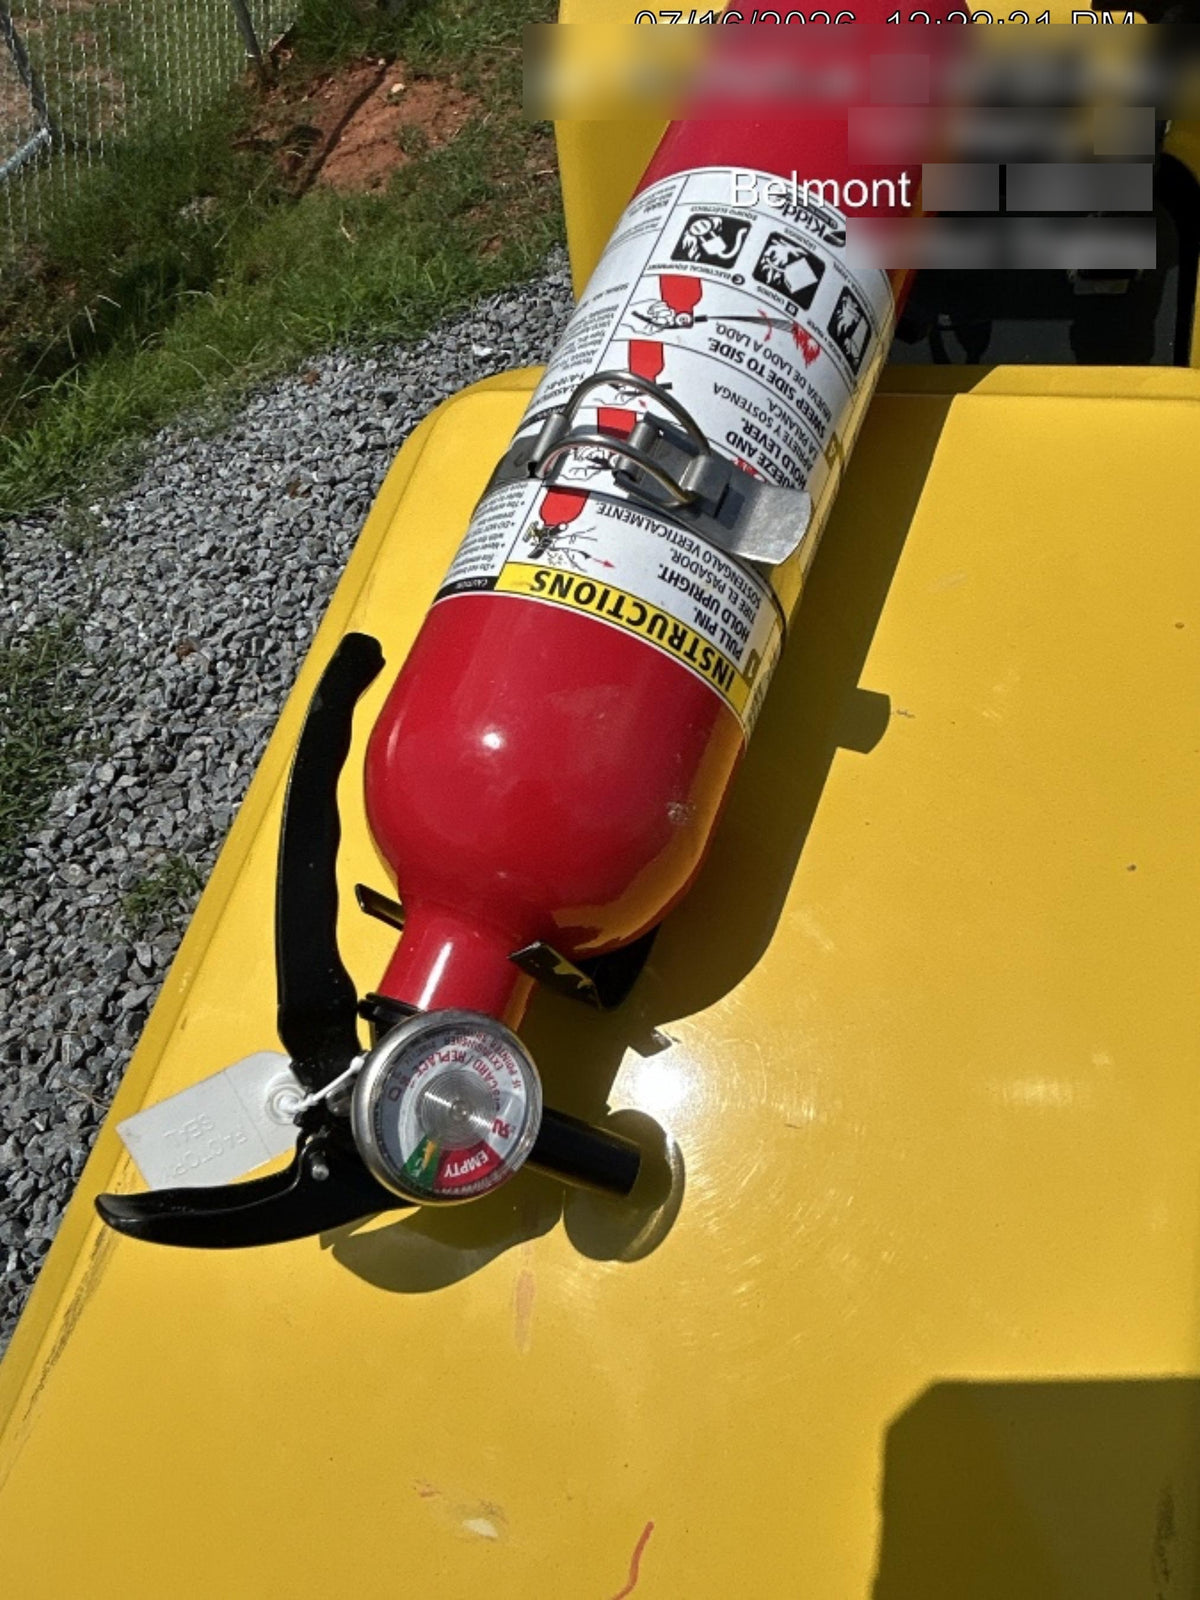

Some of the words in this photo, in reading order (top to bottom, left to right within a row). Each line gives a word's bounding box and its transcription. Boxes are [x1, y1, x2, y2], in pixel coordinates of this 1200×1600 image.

[714, 320, 751, 347] LADO.
[752, 340, 767, 353] A
[706, 336, 746, 364] SIDE.
[763, 349, 798, 378] LADO
[747, 358, 771, 380] TO
[797, 371, 811, 389] DE
[765, 370, 797, 400] SIDE
[712, 382, 774, 429] SOSTENGA
[766, 397, 809, 444] PALANCA.
[796, 398, 826, 440] SWEEP
[725, 430, 760, 458] AND
[740, 416, 782, 456] LEVER.
[772, 425, 784, 437] Y
[757, 452, 796, 488] UEEZE
[781, 455, 808, 491] HOLD
[596, 500, 703, 553] VERTICALMENTE.
[669, 547, 726, 595] PASADOR.
[656, 562, 722, 621] UPRIGHT.
[723, 588, 740, 606] EL
[691, 606, 720, 636] PIN.
[720, 608, 751, 644] HOLD
[736, 598, 757, 625] TIRE
[529, 569, 736, 693] INSTRUCTIONS
[717, 626, 744, 662] PULL
[444, 1149, 489, 1178] EMPTY
